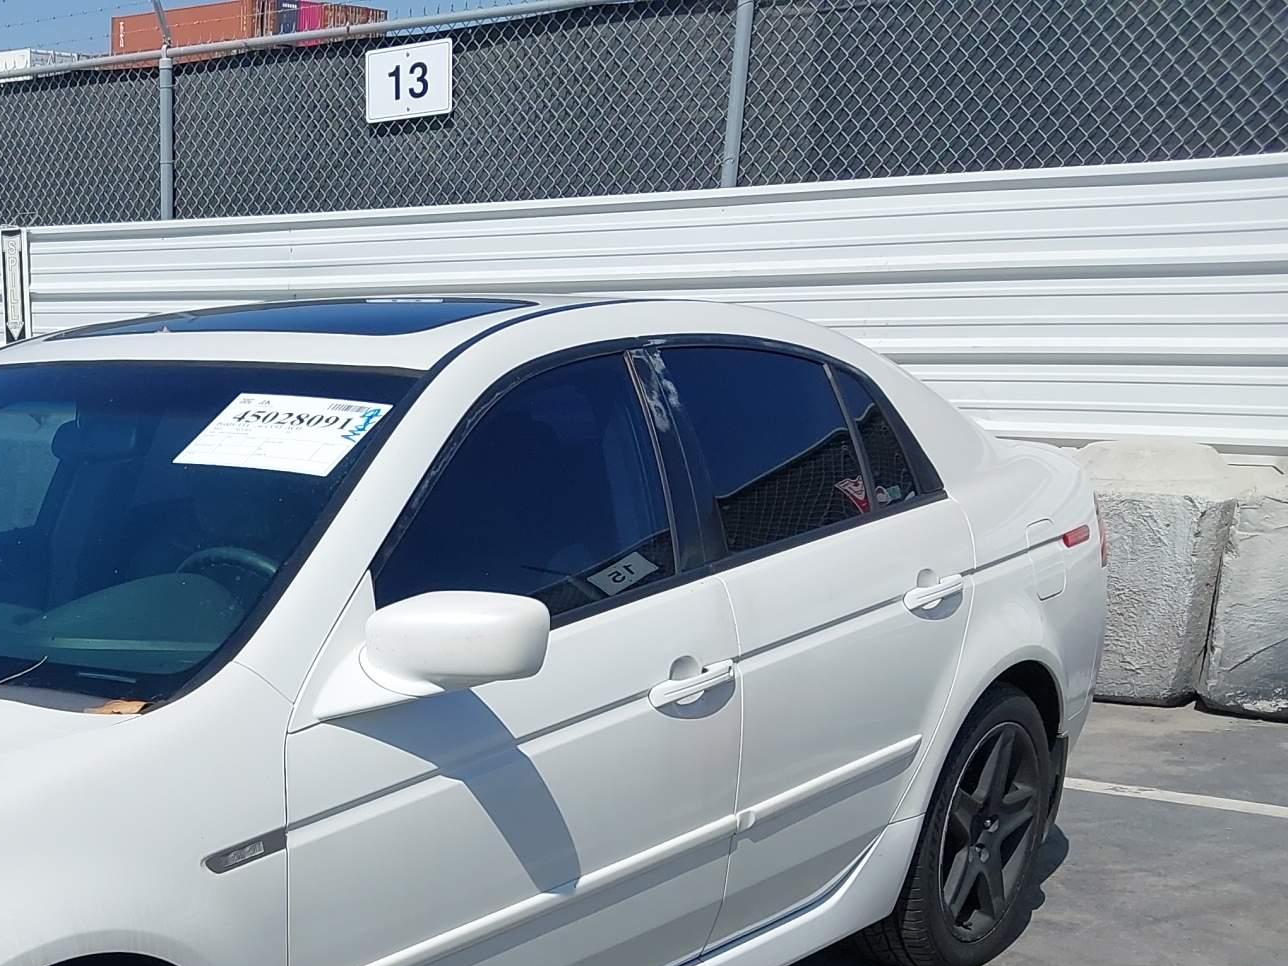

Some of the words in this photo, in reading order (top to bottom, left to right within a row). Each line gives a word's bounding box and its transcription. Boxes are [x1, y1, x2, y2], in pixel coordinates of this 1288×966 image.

[388, 61, 429, 101] 13
[7, 240, 20, 321] SPILL
[232, 410, 353, 430] 45028091
